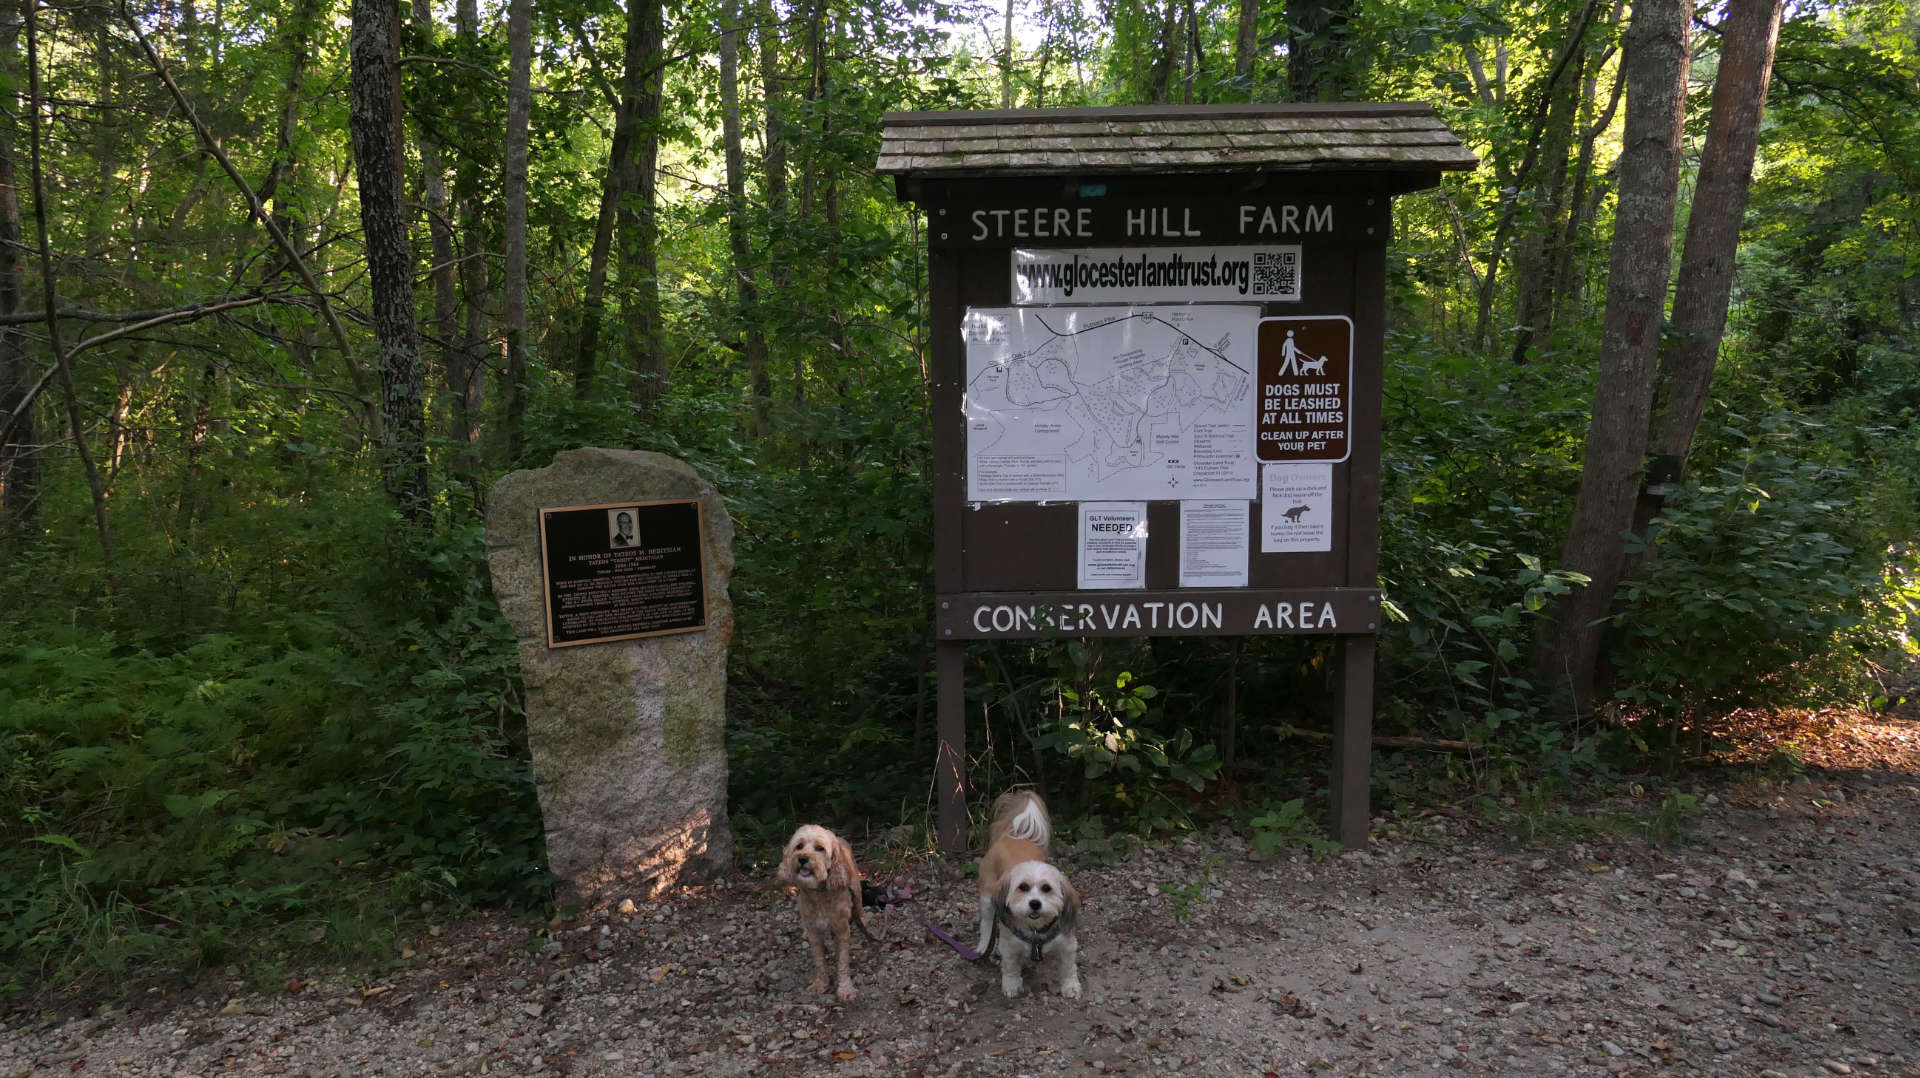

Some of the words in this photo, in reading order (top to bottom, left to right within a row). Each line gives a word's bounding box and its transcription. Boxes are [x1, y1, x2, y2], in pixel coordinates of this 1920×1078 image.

[972, 207, 1092, 241] STEERE
[1126, 207, 1201, 237] HILL
[1239, 205, 1334, 234] FARM
[1017, 252, 1249, 297] www.glocesterlandtrust.org
[1265, 384, 1300, 396] DOGS
[1304, 383, 1340, 396] MUST
[1264, 399, 1281, 410] BE
[1285, 398, 1341, 410] LEASHED
[1262, 412, 1277, 424] AT
[1280, 412, 1302, 424] ALL
[1305, 412, 1344, 424] TIMES
[1260, 431, 1293, 441] CLEAN
[1295, 431, 1310, 440] UP
[1311, 430, 1344, 439] AFTER
[1278, 442, 1305, 451] YOUR
[1307, 441, 1326, 450] PET
[1091, 523, 1133, 532] NEEDED
[1253, 602, 1337, 630] AREA
